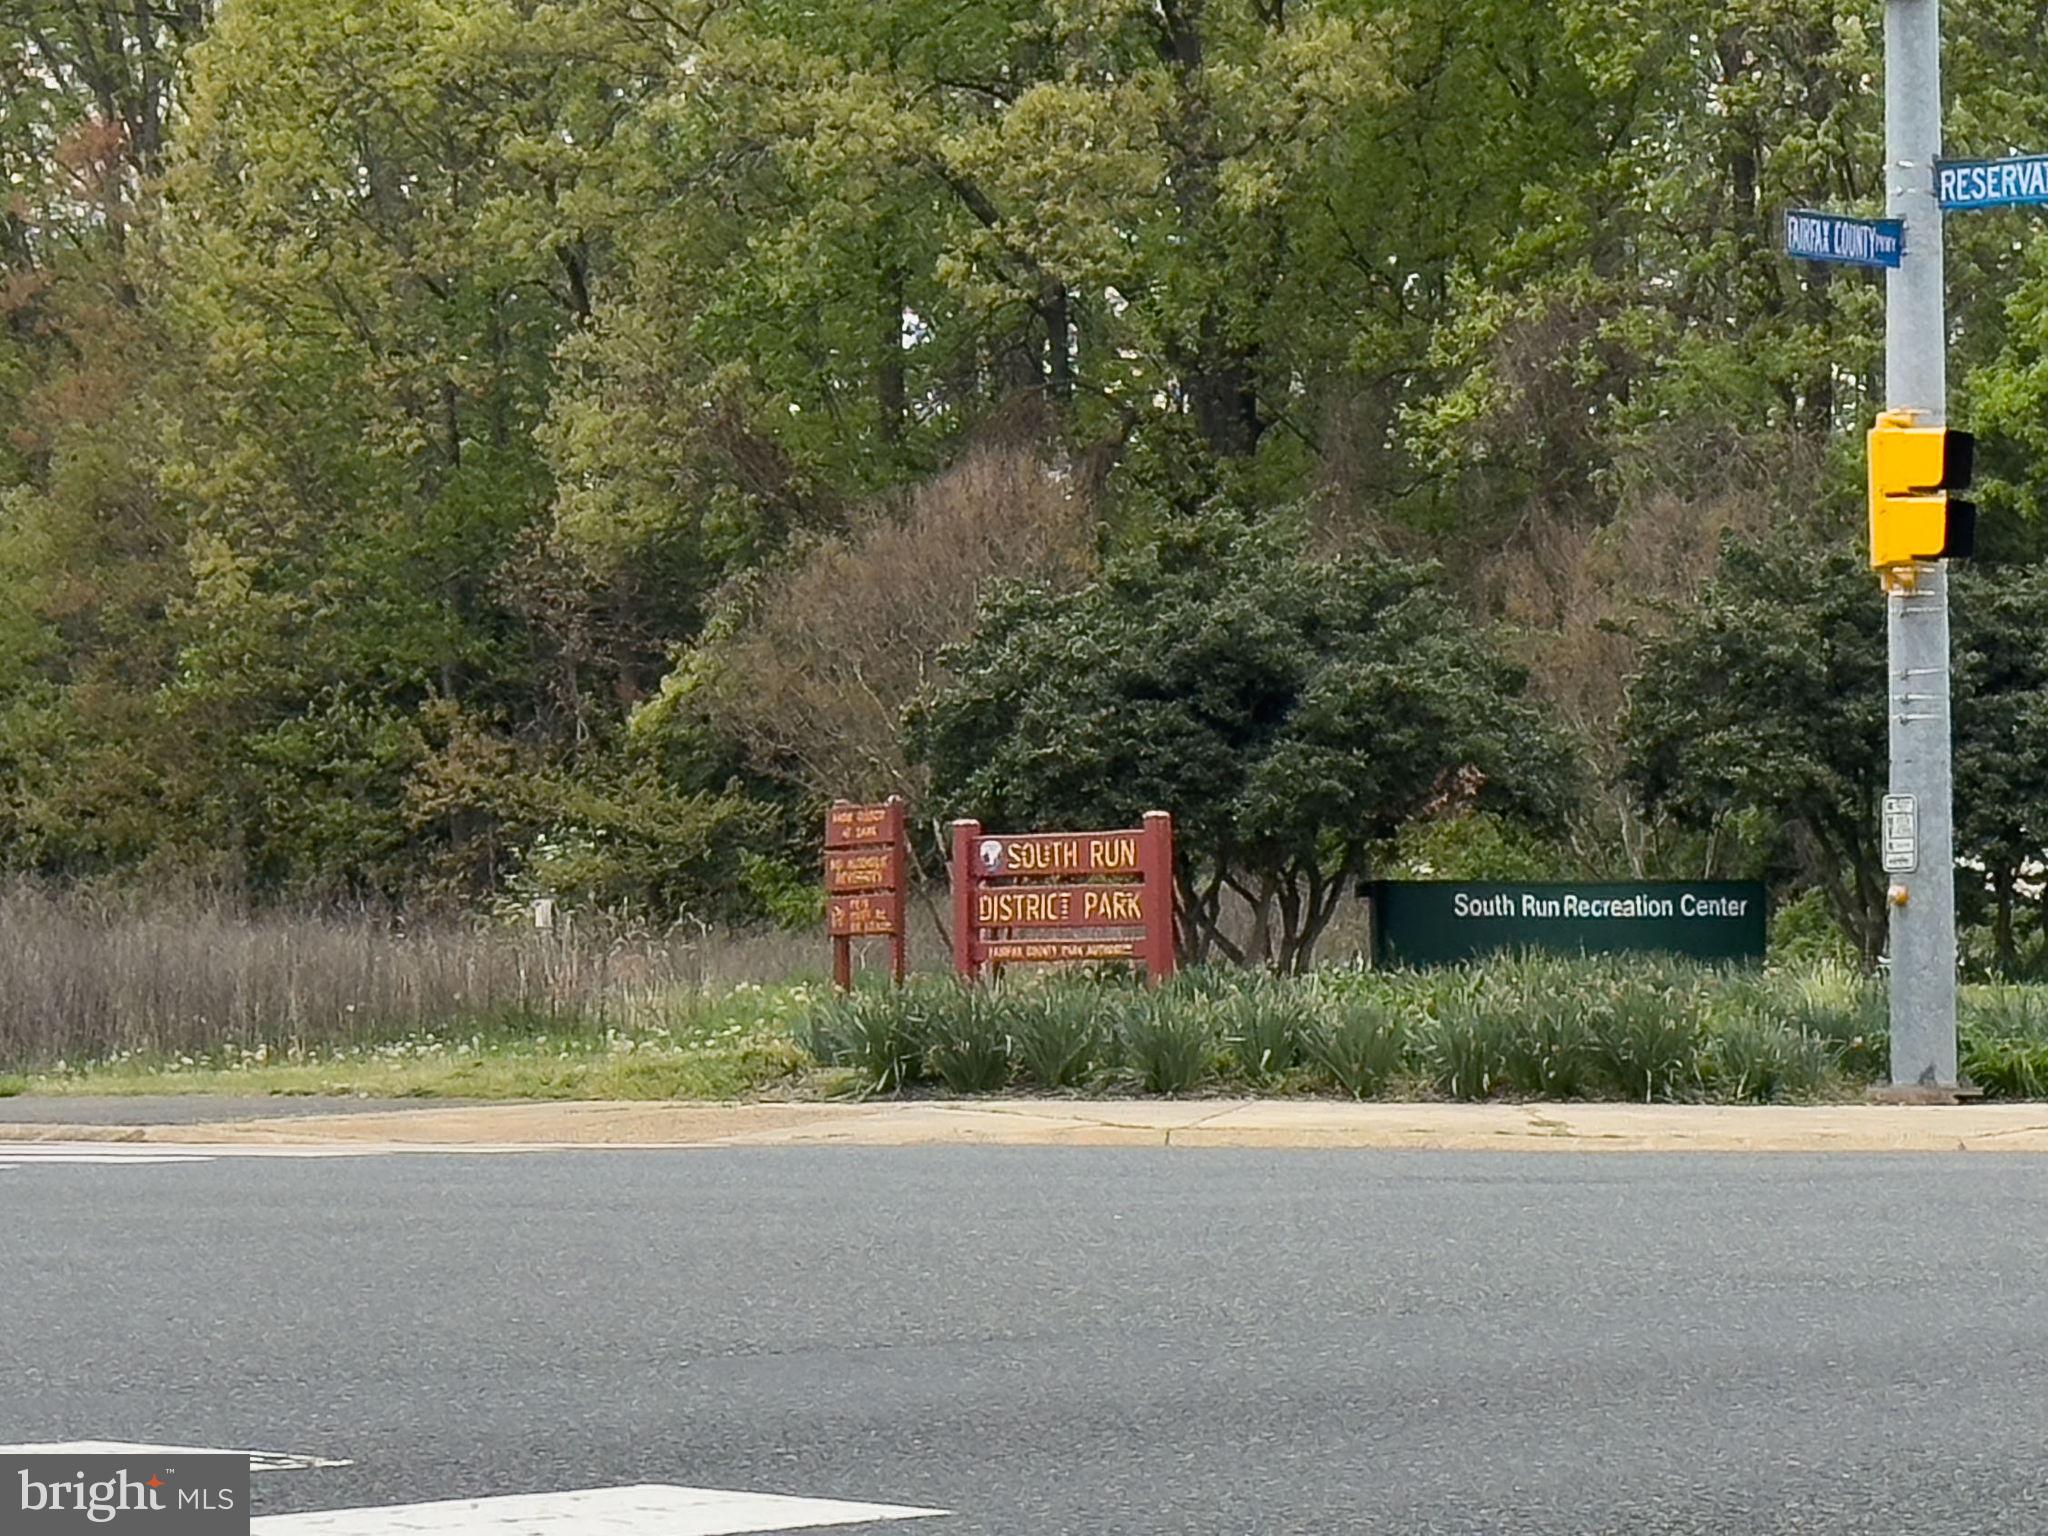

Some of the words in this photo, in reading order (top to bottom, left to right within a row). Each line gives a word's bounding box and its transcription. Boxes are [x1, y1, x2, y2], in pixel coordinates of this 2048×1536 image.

[1787, 217, 1830, 252] FAIRFAX
[1834, 222, 1876, 259] COUNTY
[1007, 840, 1077, 870] SOUTH
[1089, 838, 1136, 867] RUN
[979, 891, 1071, 922] DISTRICT
[1084, 891, 1142, 919] PARK
[1453, 893, 1515, 918] South
[1522, 893, 1560, 918] Run
[1564, 893, 1673, 918] Recreation
[1680, 893, 1748, 917] Center
